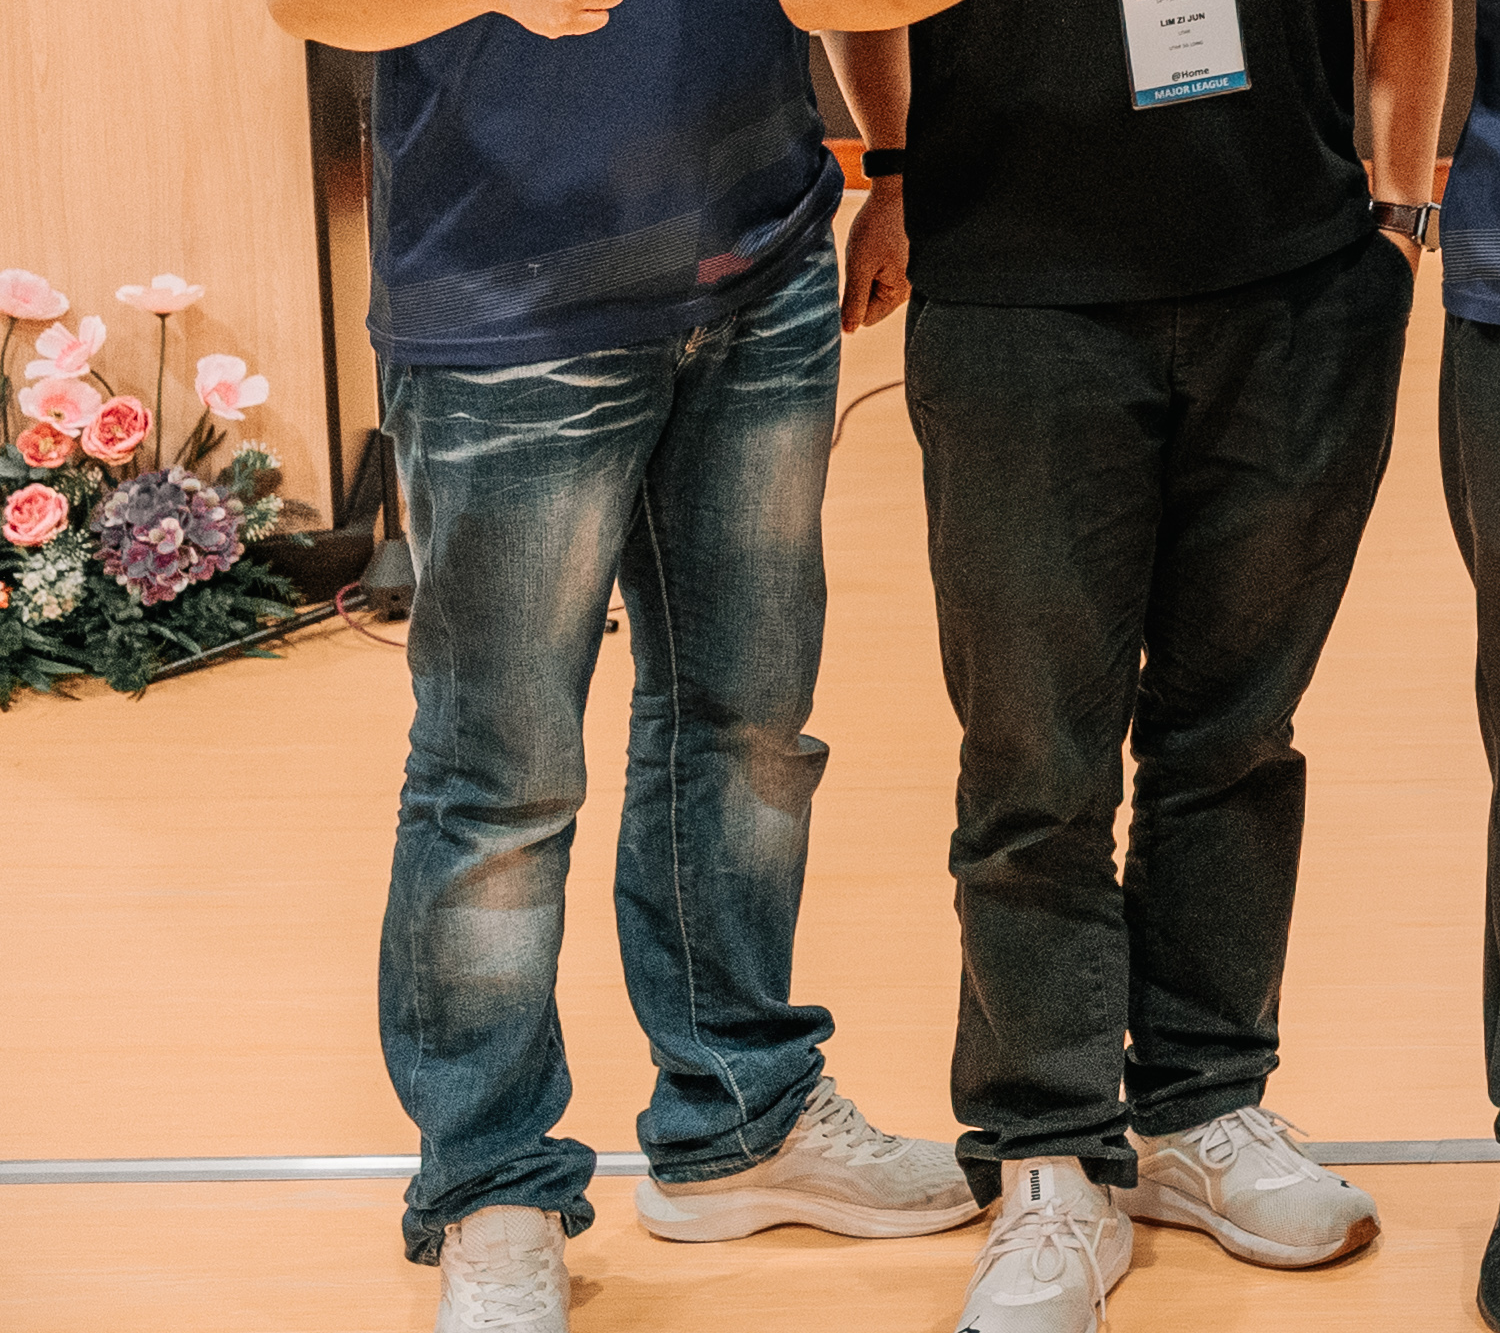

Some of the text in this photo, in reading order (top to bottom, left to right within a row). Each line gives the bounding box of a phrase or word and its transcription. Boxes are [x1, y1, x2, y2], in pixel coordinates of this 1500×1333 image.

[1160, 12, 1205, 27] LIM ZI JUN
[1172, 68, 1210, 81] @Home
[1154, 77, 1229, 100] MAJOR LEAGUE
